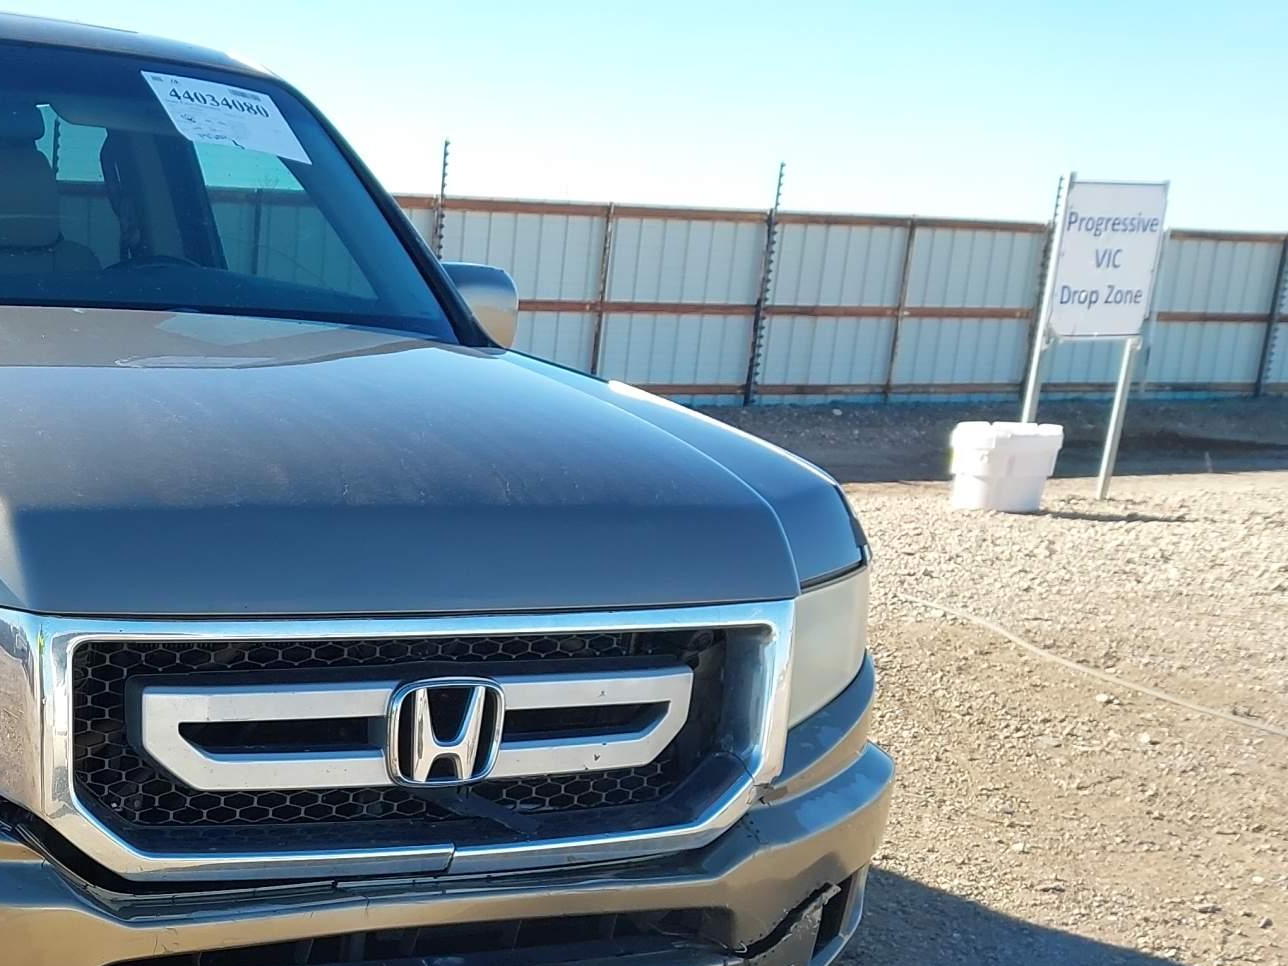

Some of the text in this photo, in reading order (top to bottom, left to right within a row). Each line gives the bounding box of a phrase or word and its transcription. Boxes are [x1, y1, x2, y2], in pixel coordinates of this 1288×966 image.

[169, 88, 269, 118] 44034080
[1066, 211, 1159, 237] Progressive
[1095, 248, 1123, 269] VIC
[1059, 284, 1143, 310] Drop Zone
